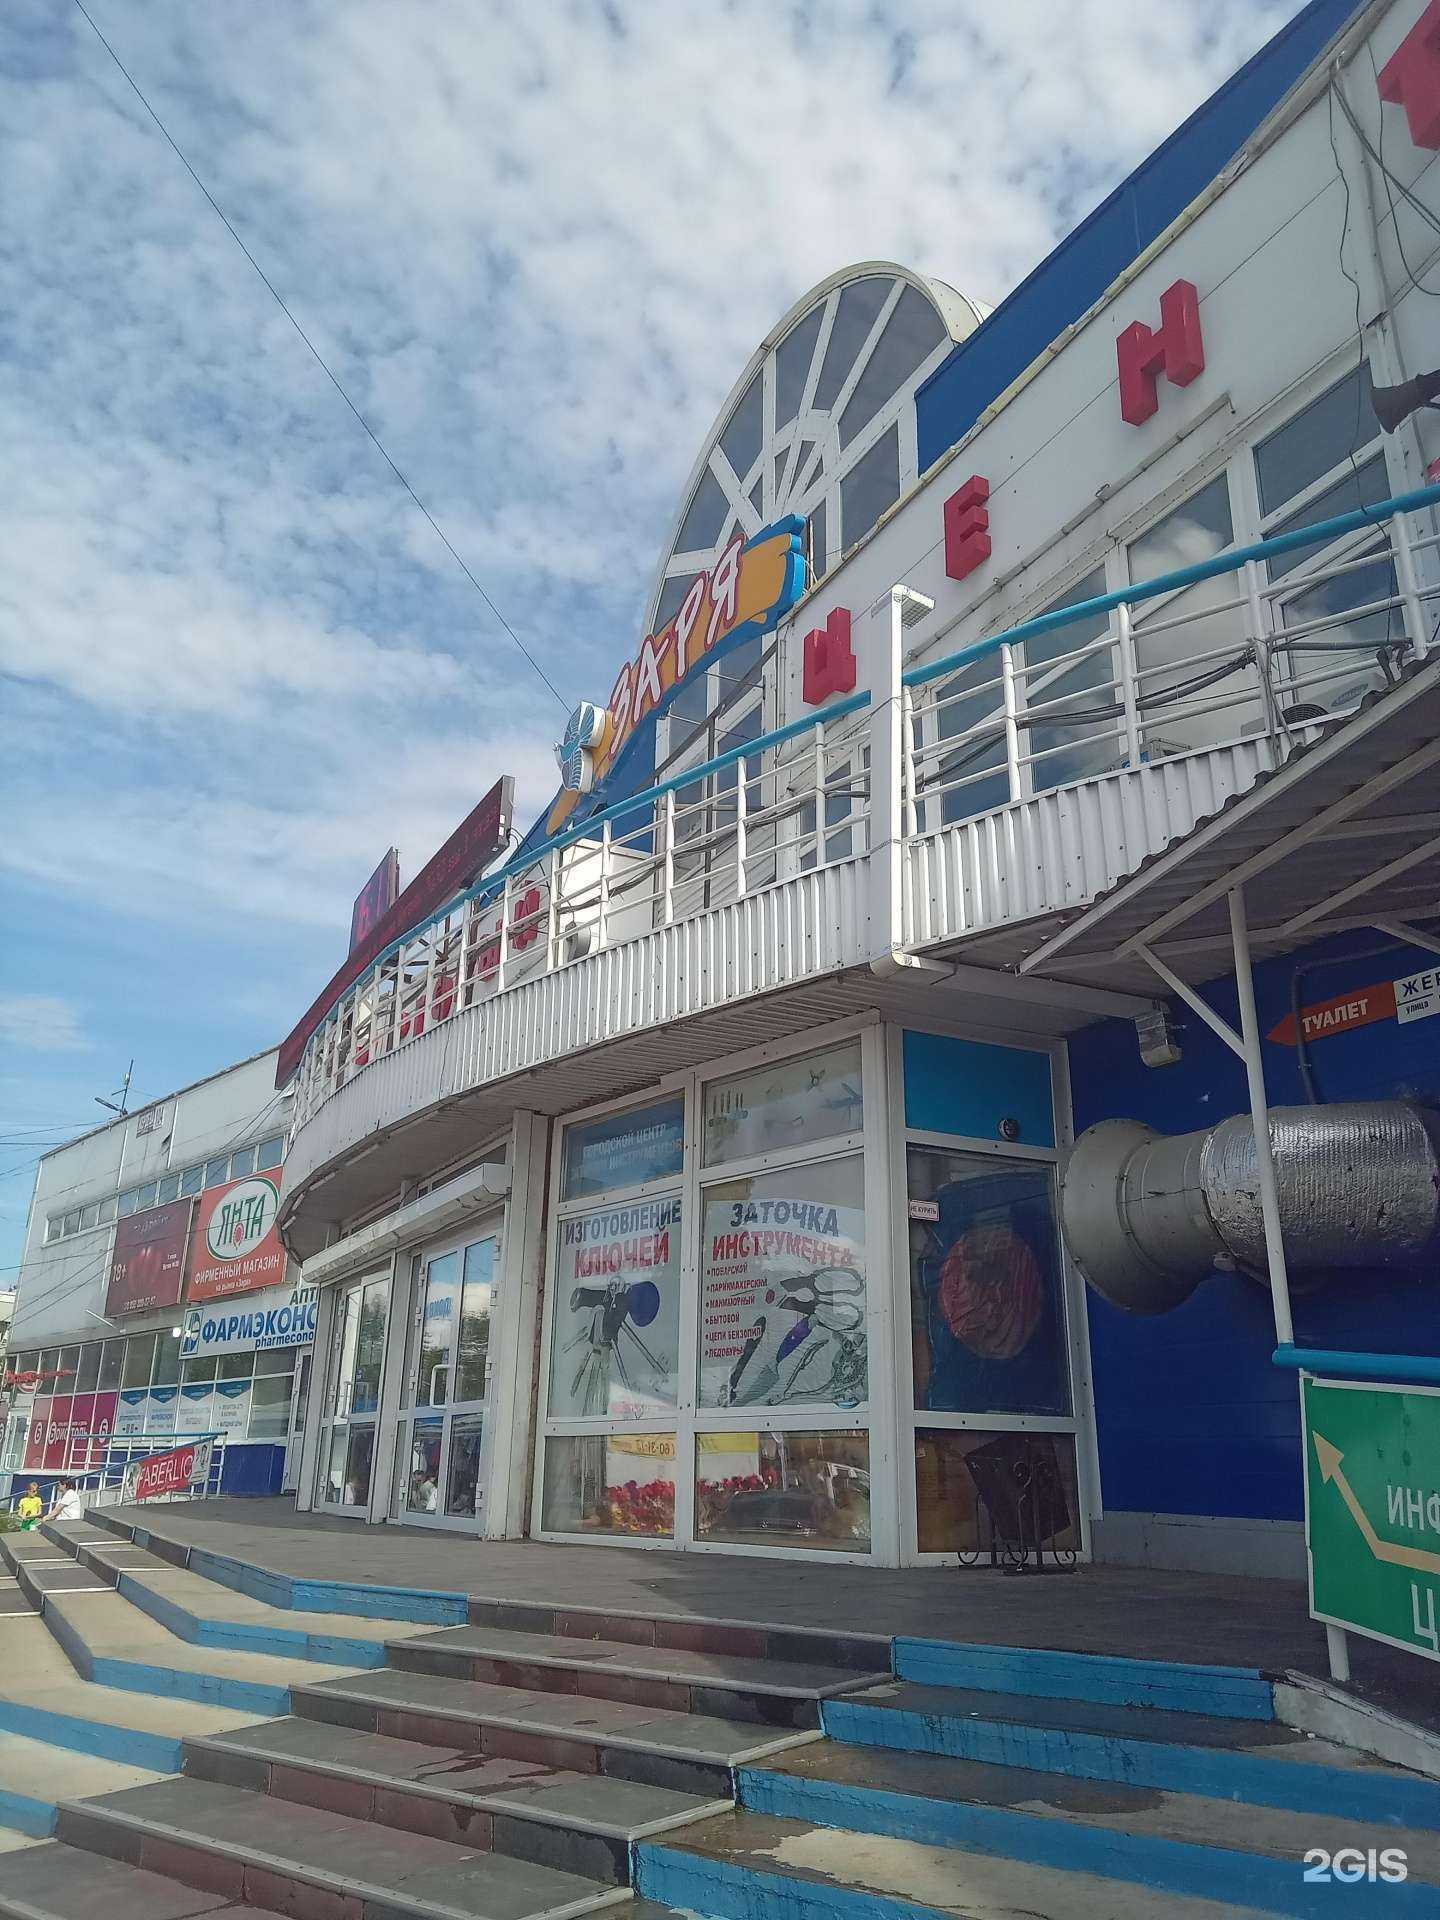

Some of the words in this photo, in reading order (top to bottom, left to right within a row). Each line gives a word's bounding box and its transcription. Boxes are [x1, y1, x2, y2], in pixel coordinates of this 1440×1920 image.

[607, 533, 748, 762] ЗАРЯ
[1302, 998, 1368, 1033] ТУАЛЕТ
[636, 1123, 667, 1146] ЦЕНТР
[565, 1199, 682, 1245] ИЗГОТОВЛЕНИЕ
[730, 1200, 839, 1238] ЗАТОЧКА
[574, 1226, 669, 1279] КЛЮЧЕЙ
[712, 1230, 853, 1265] ИНСТРУМЕНТА
[112, 1263, 128, 1284] 18+
[194, 1260, 242, 1285] ФИРМЕННЫЙ
[243, 1254, 281, 1276] МАГАЗИН
[709, 1312, 740, 1325] БЫТОВОЙ
[255, 1330, 314, 1351] pharmecono
[138, 1454, 194, 1490] FABERLIC
